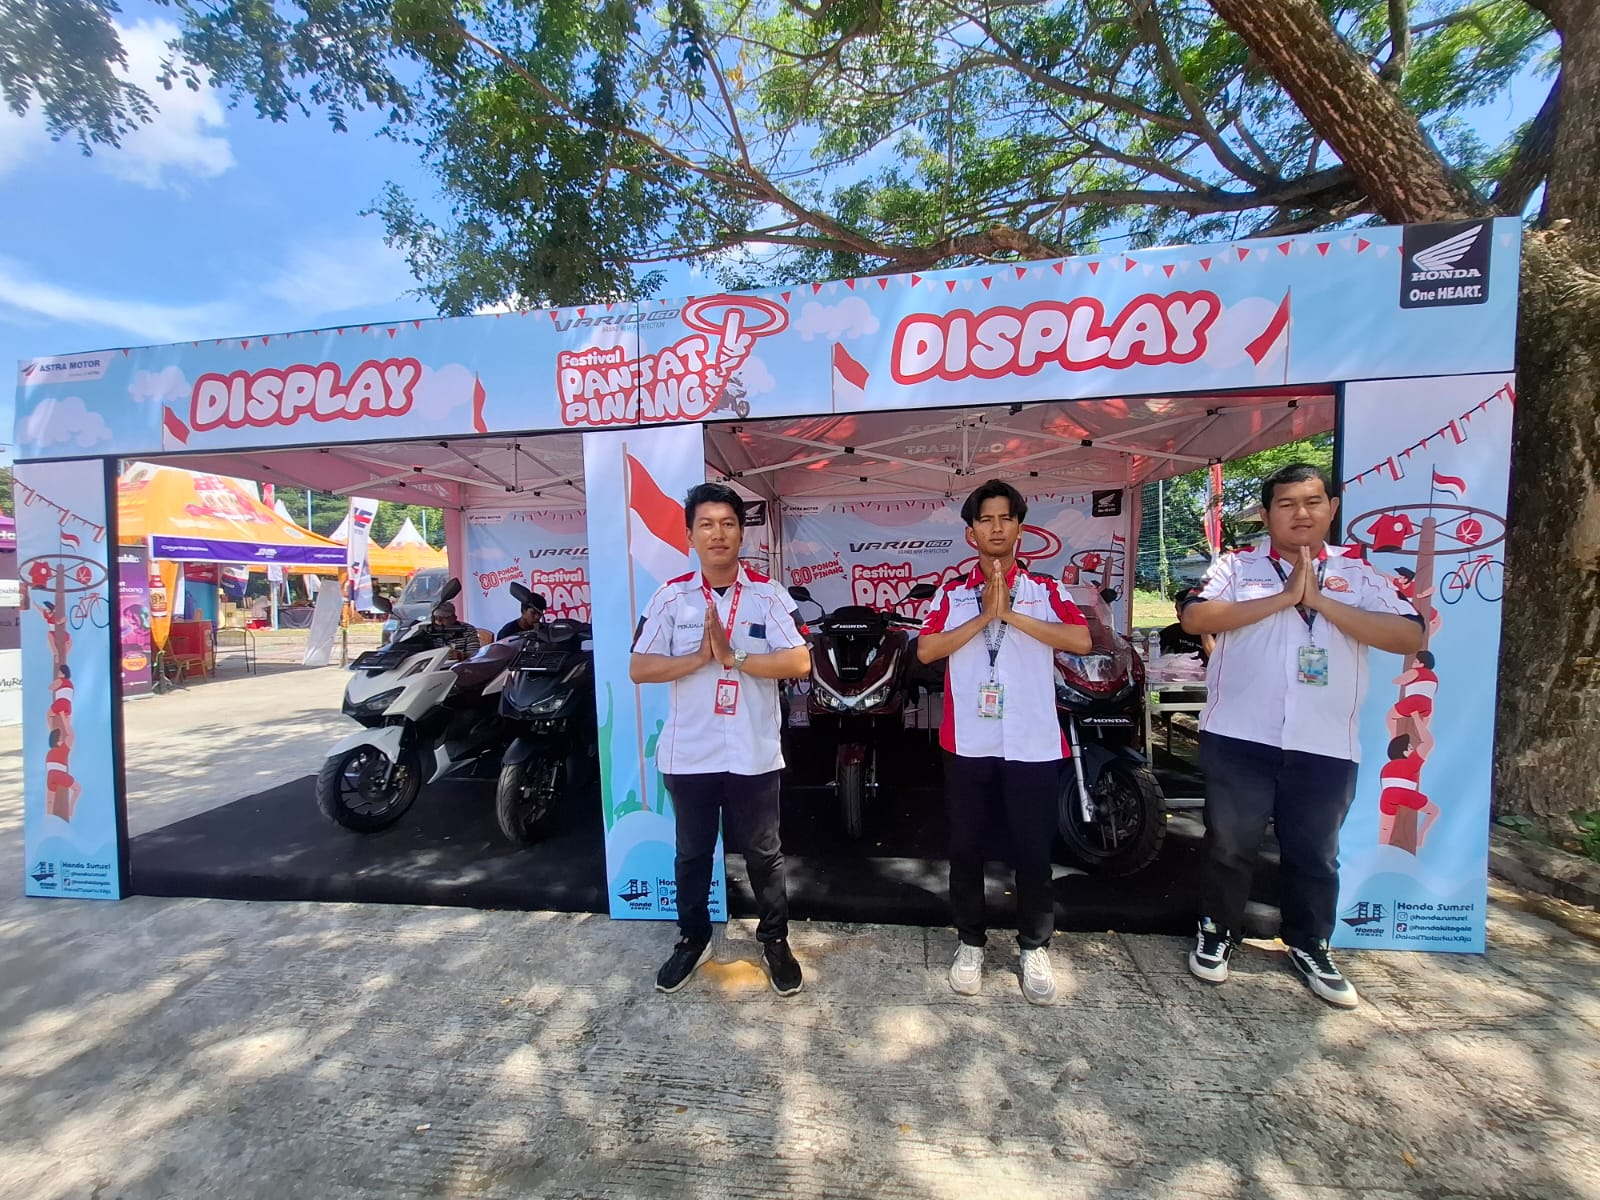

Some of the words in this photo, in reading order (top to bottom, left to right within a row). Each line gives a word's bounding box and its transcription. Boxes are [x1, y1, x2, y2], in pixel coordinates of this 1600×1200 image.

[1411, 268, 1482, 282] HONDA
[1409, 289, 1436, 301] One
[1437, 285, 1482, 300] HEART.
[553, 313, 645, 333] VARIO
[896, 295, 1216, 380] DISPLAY
[39, 362, 67, 372] ASTRA
[69, 360, 101, 369] MOTOR
[560, 350, 621, 367] Festival
[560, 338, 705, 404] PANJAT
[194, 361, 418, 428] DISPLAY
[565, 374, 708, 422] PINANG
[849, 541, 925, 553] VARIO
[533, 569, 582, 583] Festival
[791, 566, 813, 586] 80
[855, 564, 910, 579] Festival
[1064, 570, 1074, 579] Rp
[1397, 902, 1434, 911] Honda
[1436, 903, 1474, 912] Sumsel
